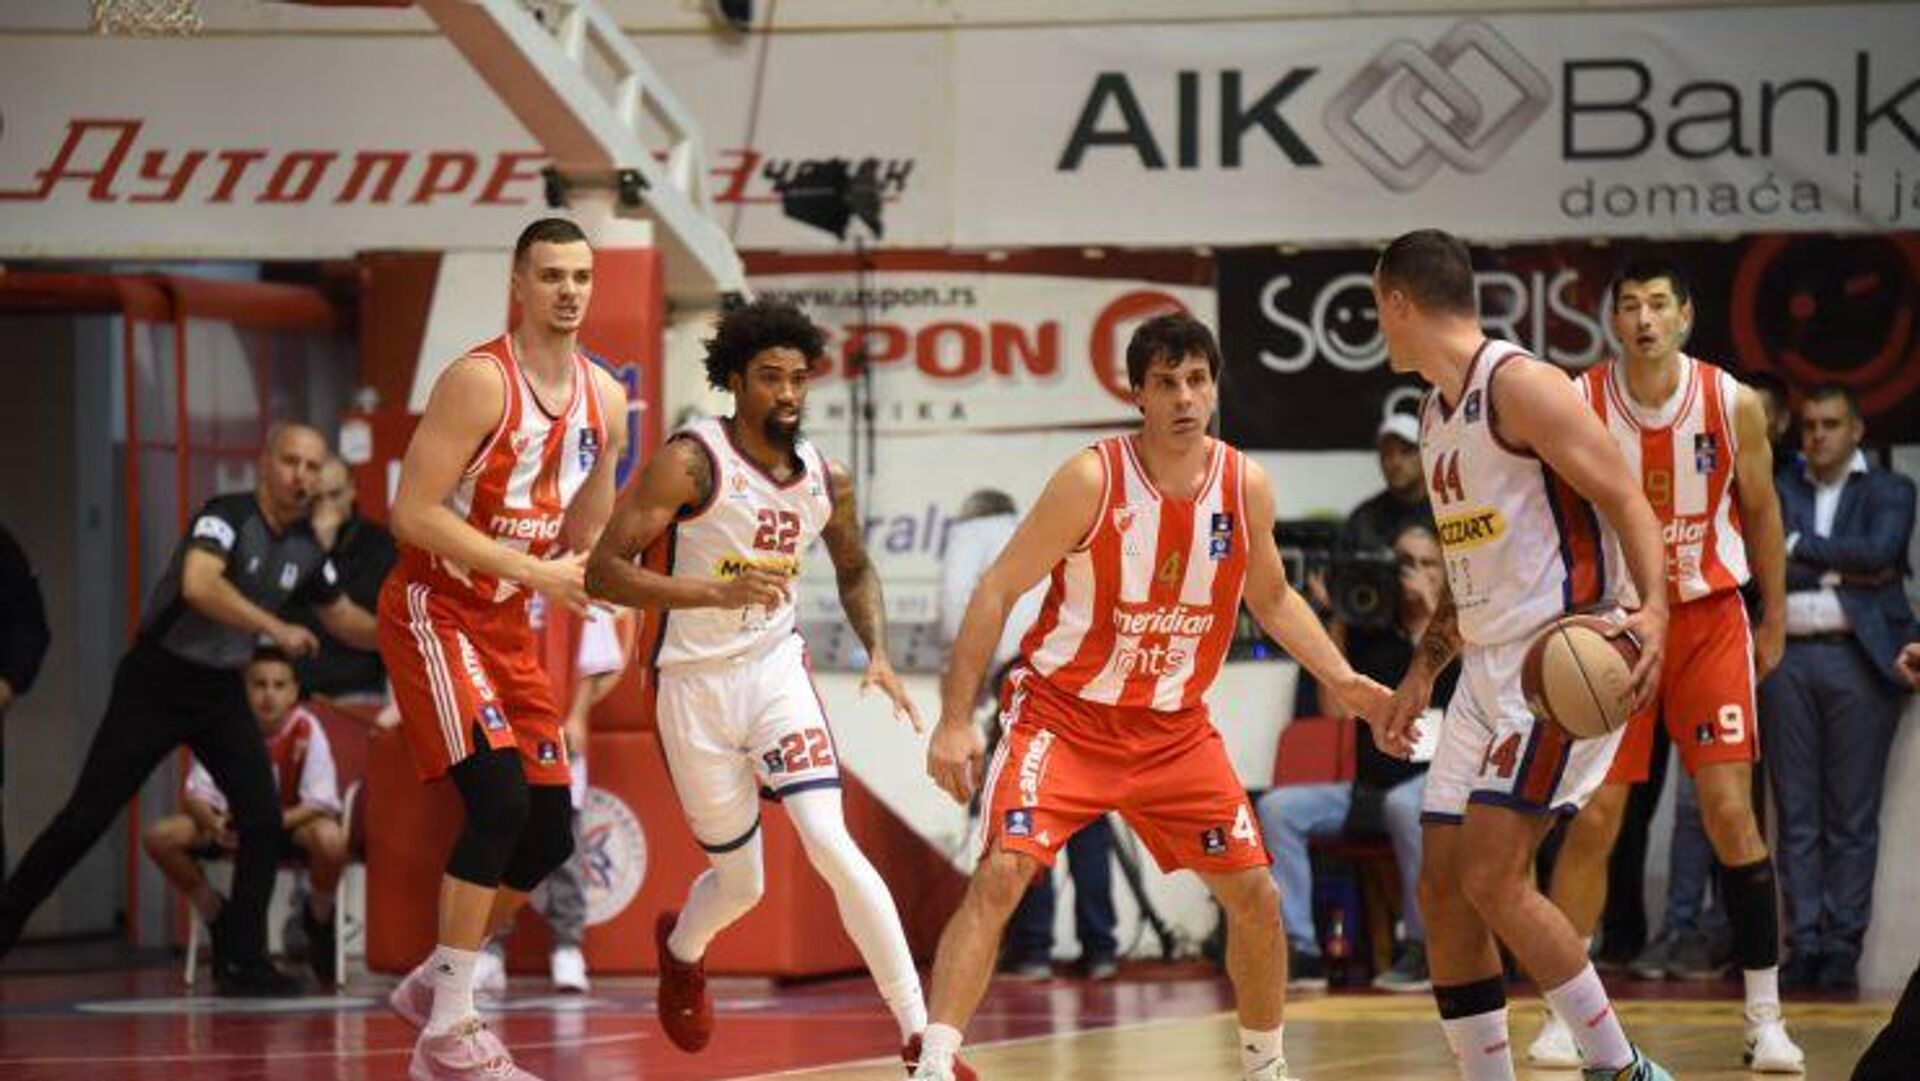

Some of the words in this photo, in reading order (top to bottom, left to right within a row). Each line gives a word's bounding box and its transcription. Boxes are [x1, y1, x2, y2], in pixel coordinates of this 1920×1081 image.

[1055, 66, 1323, 171] AIK
[1562, 51, 1920, 161] Bank
[1559, 170, 1822, 218] domaća
[1852, 171, 1863, 214] i
[1432, 450, 1465, 504] 44
[752, 508, 800, 554] 22
[1158, 551, 1182, 588] 4
[1113, 605, 1215, 635] meridian
[1114, 643, 1186, 676] mts
[1718, 704, 1744, 743] 9
[779, 728, 833, 773] 22
[1230, 803, 1258, 847] 4
